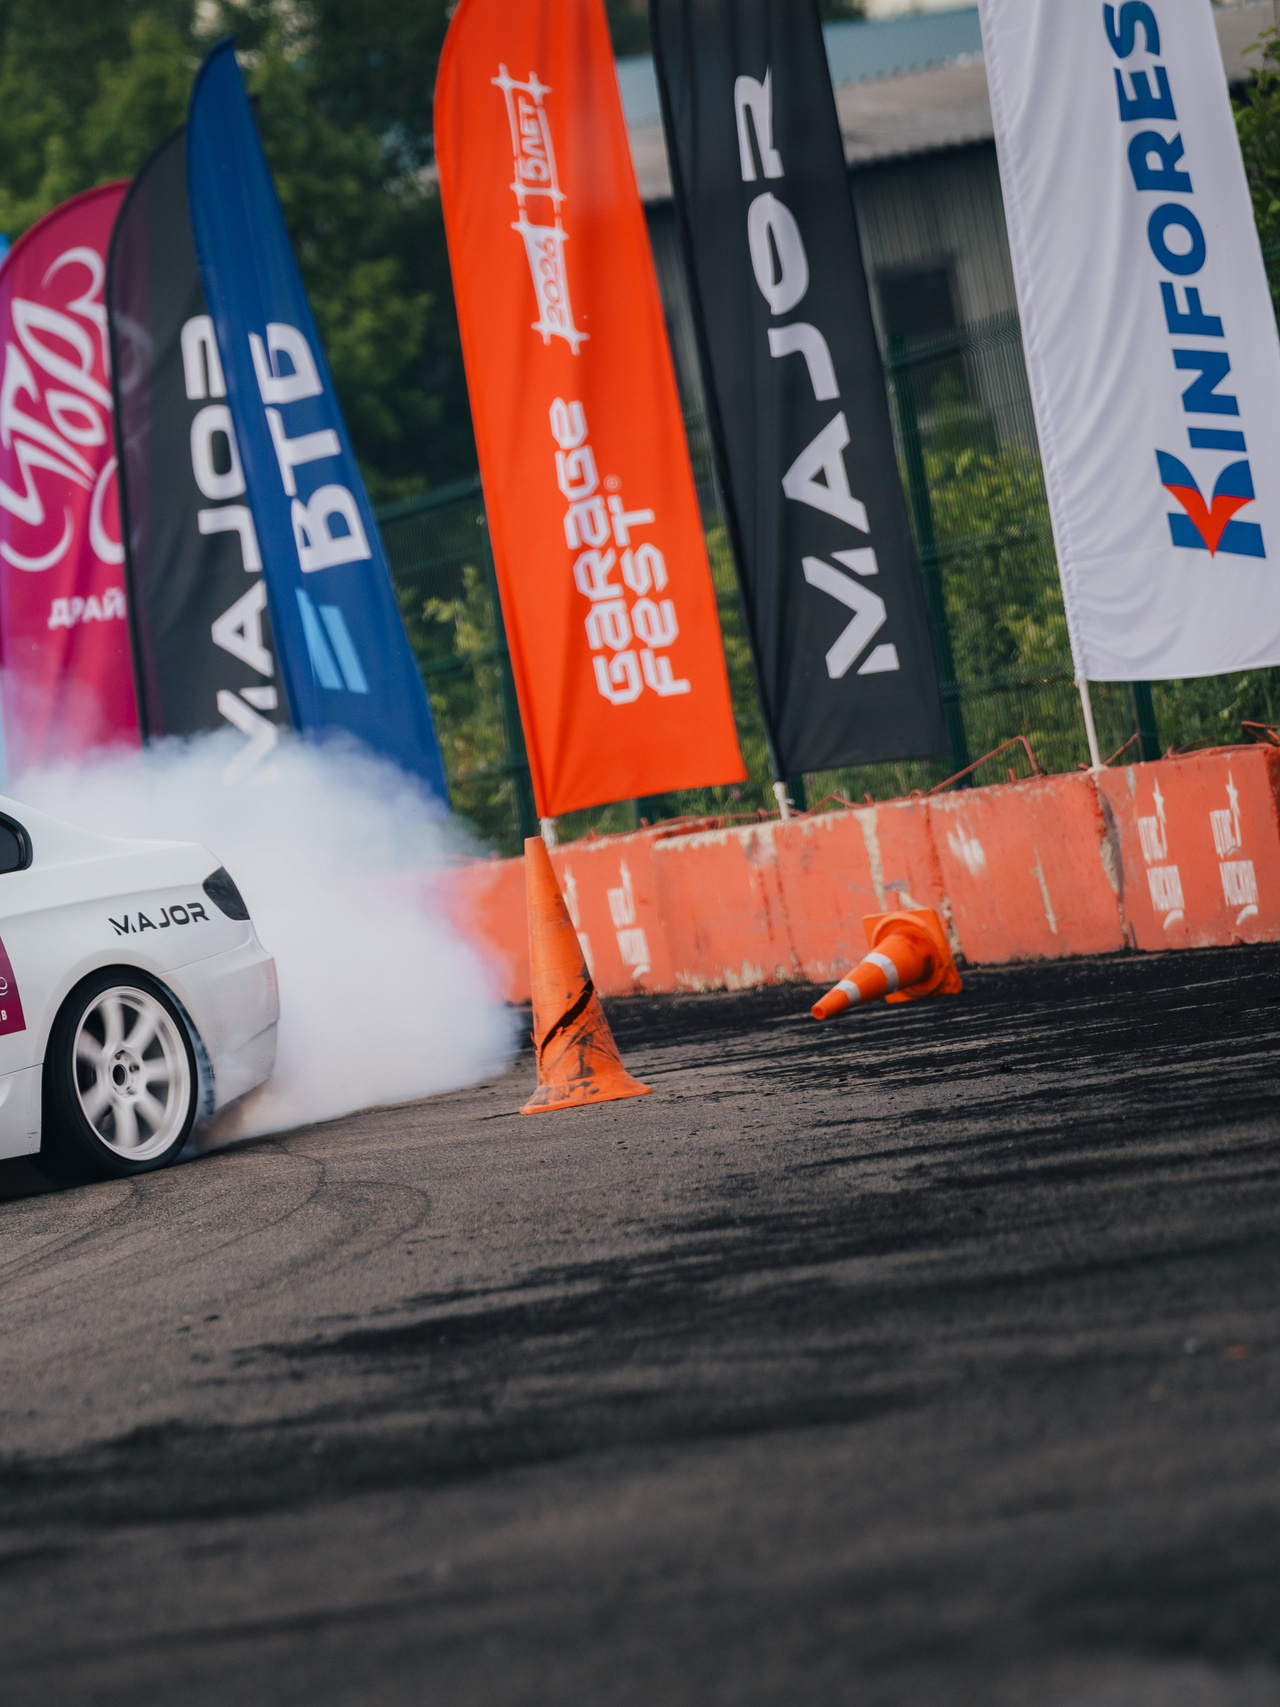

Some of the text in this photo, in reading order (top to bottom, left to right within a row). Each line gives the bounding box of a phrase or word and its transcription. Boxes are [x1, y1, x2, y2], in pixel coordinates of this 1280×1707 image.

[734, 64, 901, 680] MAJOR
[1102, 0, 1267, 558] KINFORES
[250, 321, 372, 573] ВТБ
[48, 586, 127, 630] ДРАЙ
[108, 902, 210, 936] MAJOR
